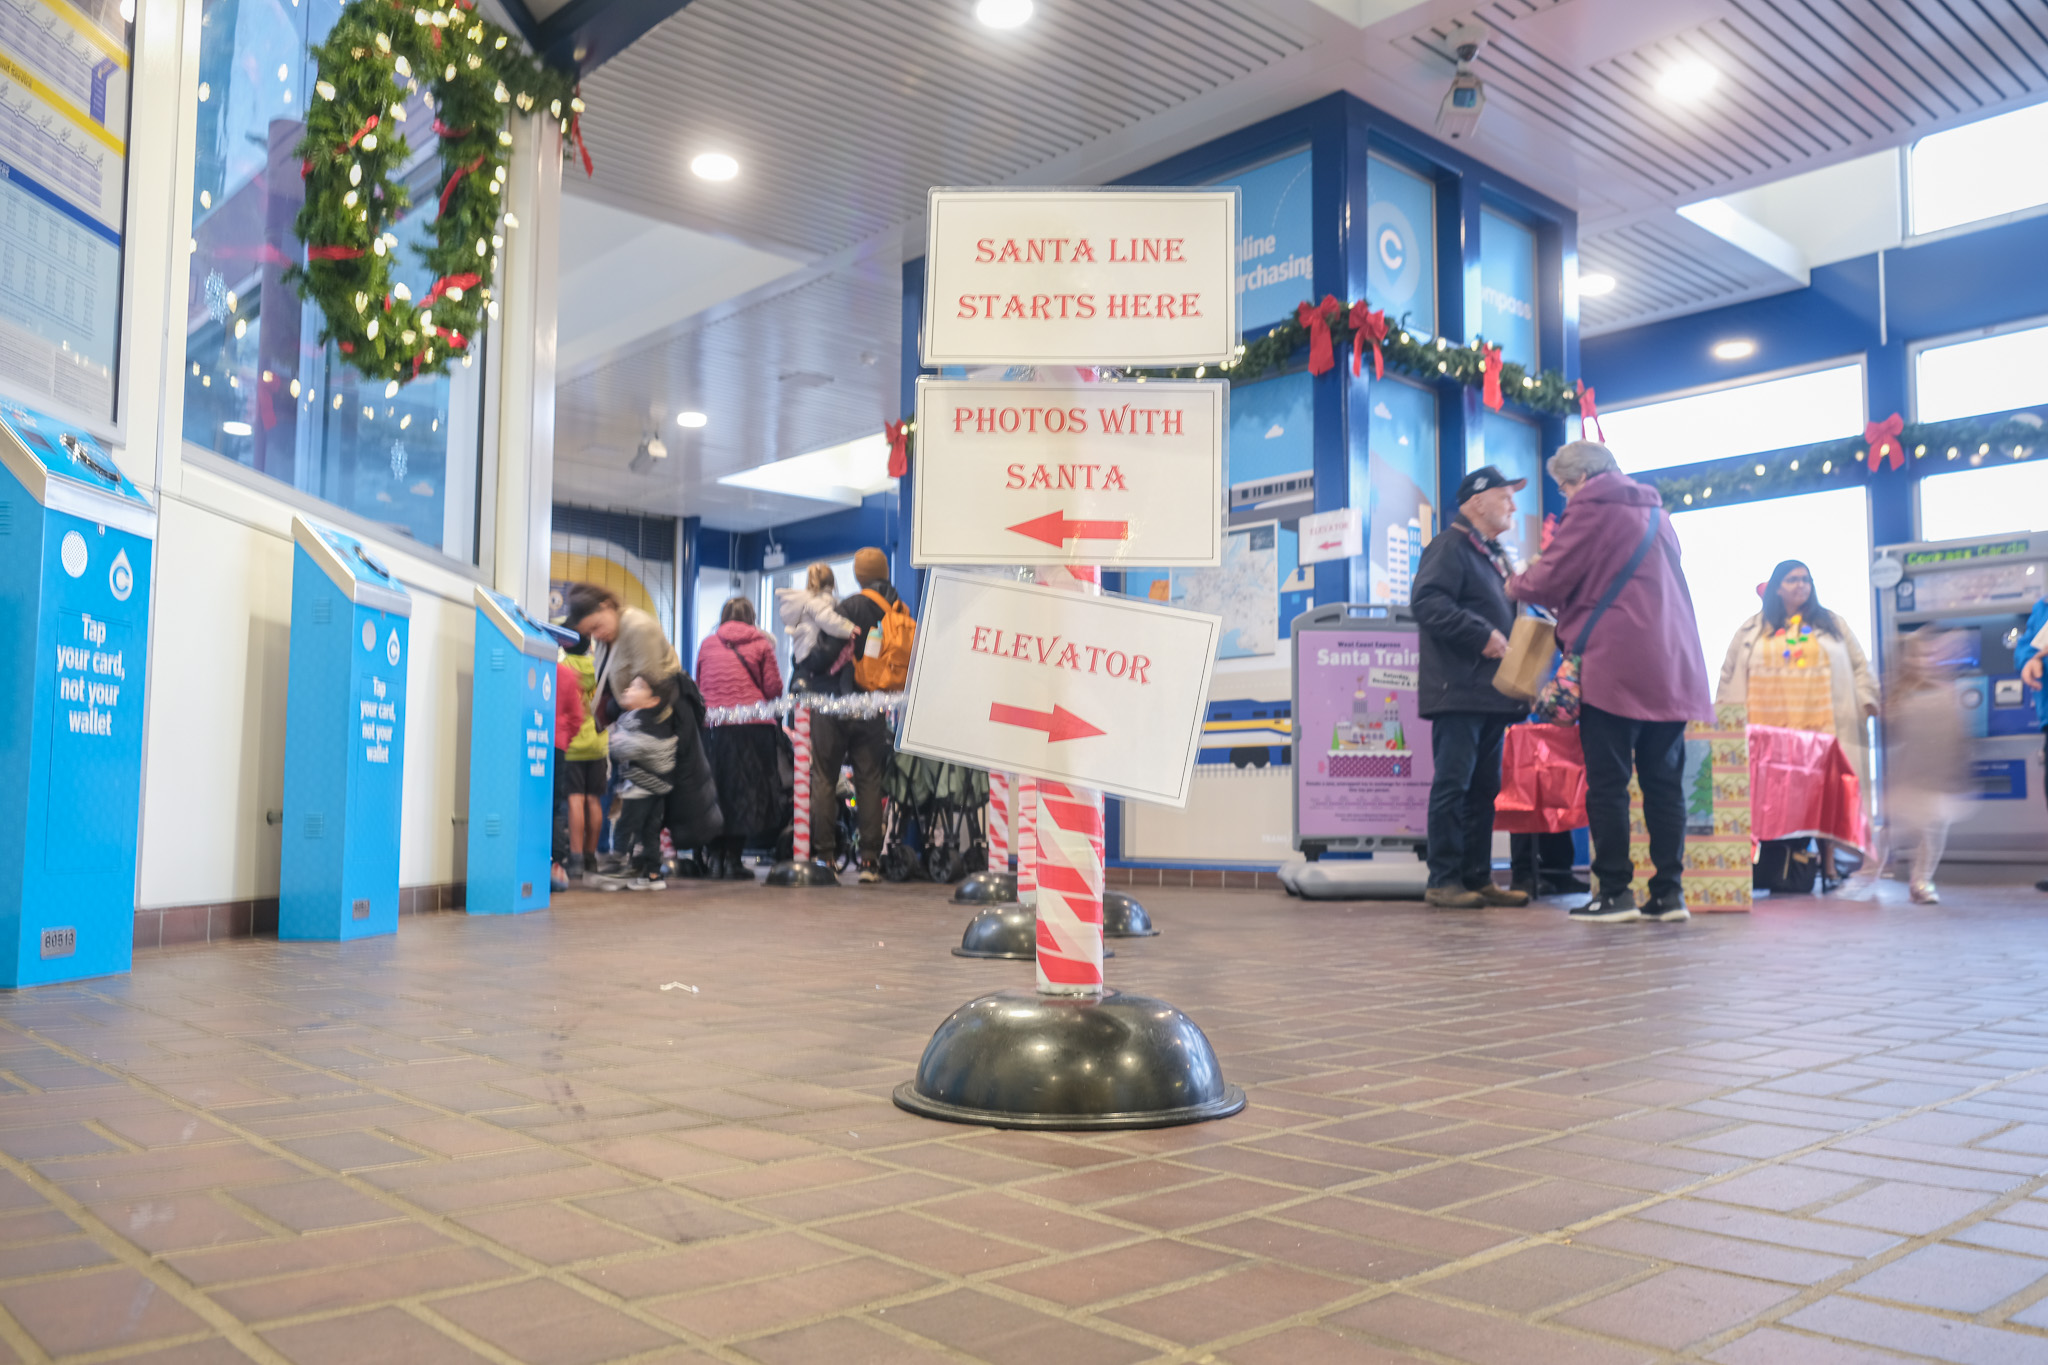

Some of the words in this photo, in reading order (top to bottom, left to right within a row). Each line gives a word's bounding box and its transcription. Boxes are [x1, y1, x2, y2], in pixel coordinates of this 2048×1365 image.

[975, 238, 1095, 263] SANTA
[1109, 238, 1185, 263] LINE
[957, 294, 1096, 321] STARTS
[1107, 293, 1202, 320] HERE
[954, 407, 1088, 434] PHOTOS
[1099, 403, 1184, 434] WITH
[1006, 463, 1128, 491] SANTA
[82, 612, 106, 649] Tap
[57, 644, 90, 677] your
[93, 649, 126, 682] card,
[971, 626, 1151, 685] ELEVATOR
[1317, 648, 1370, 666] Santa
[1375, 648, 1419, 666] Train
[60, 675, 85, 702] not
[88, 684, 120, 710] your
[373, 676, 386, 701] Tap
[69, 706, 112, 737] wallet
[361, 700, 377, 720] your
[376, 725, 393, 744] your
[366, 743, 389, 764] wallet
